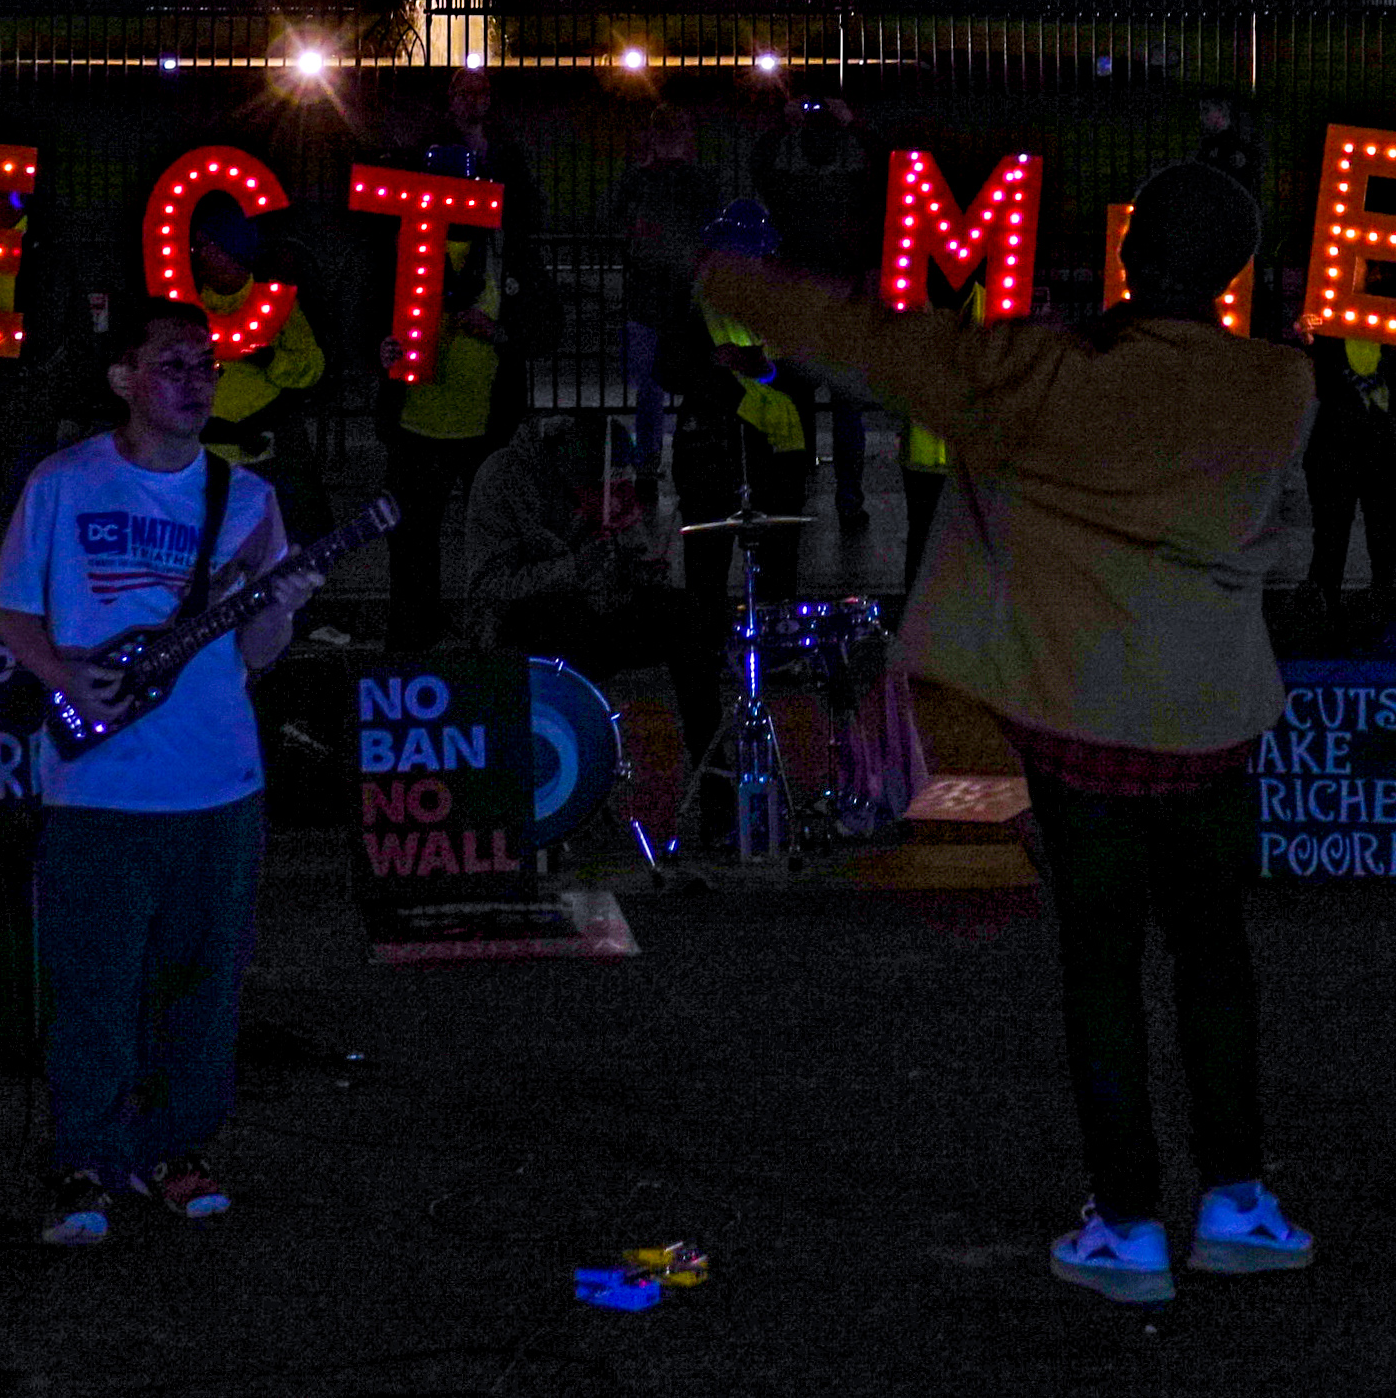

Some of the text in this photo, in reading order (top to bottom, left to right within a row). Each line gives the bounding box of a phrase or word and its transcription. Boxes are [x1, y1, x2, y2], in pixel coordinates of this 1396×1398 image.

[87, 523, 120, 542] DC
[359, 675, 450, 722] NO
[360, 724, 486, 774] BAN
[1246, 730, 1353, 775] AKE
[362, 776, 453, 827] NO
[363, 829, 520, 877] WALL
